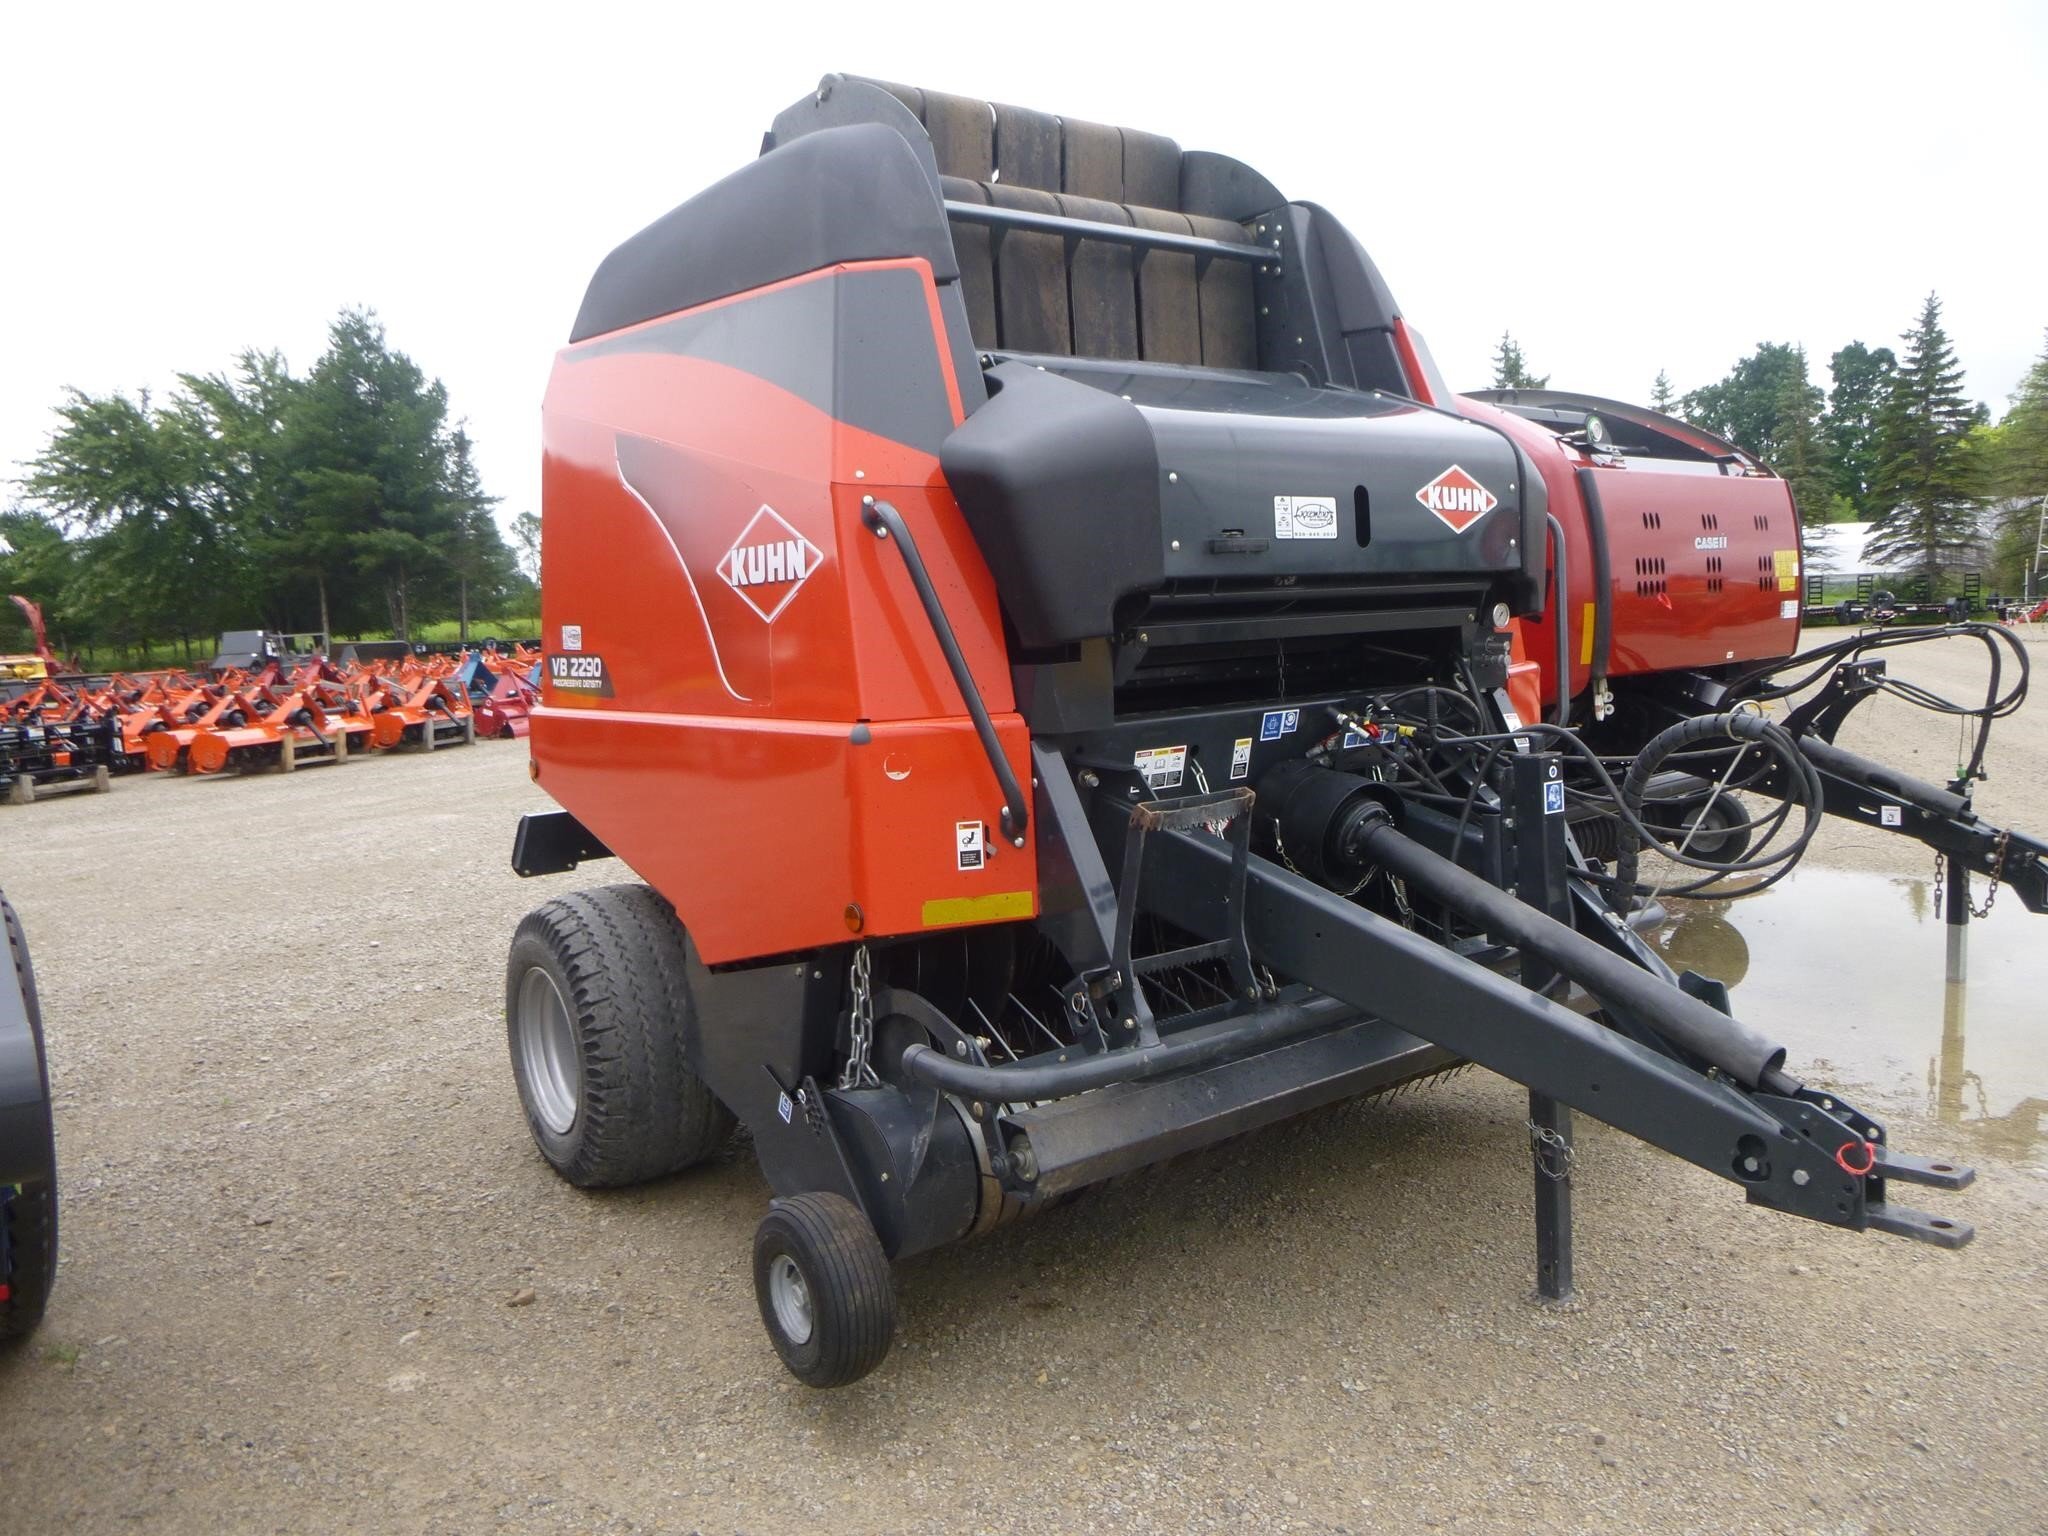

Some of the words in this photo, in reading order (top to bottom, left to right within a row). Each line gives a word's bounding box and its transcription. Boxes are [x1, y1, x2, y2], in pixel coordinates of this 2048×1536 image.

[1427, 486, 1488, 511] KUHN
[1694, 536, 1719, 549] CASE
[731, 539, 807, 587] KUHN
[552, 657, 568, 677] VB
[570, 657, 602, 677] 2290
[552, 679, 582, 688] PROGRESSIVE
[582, 680, 602, 688] DENSITY
